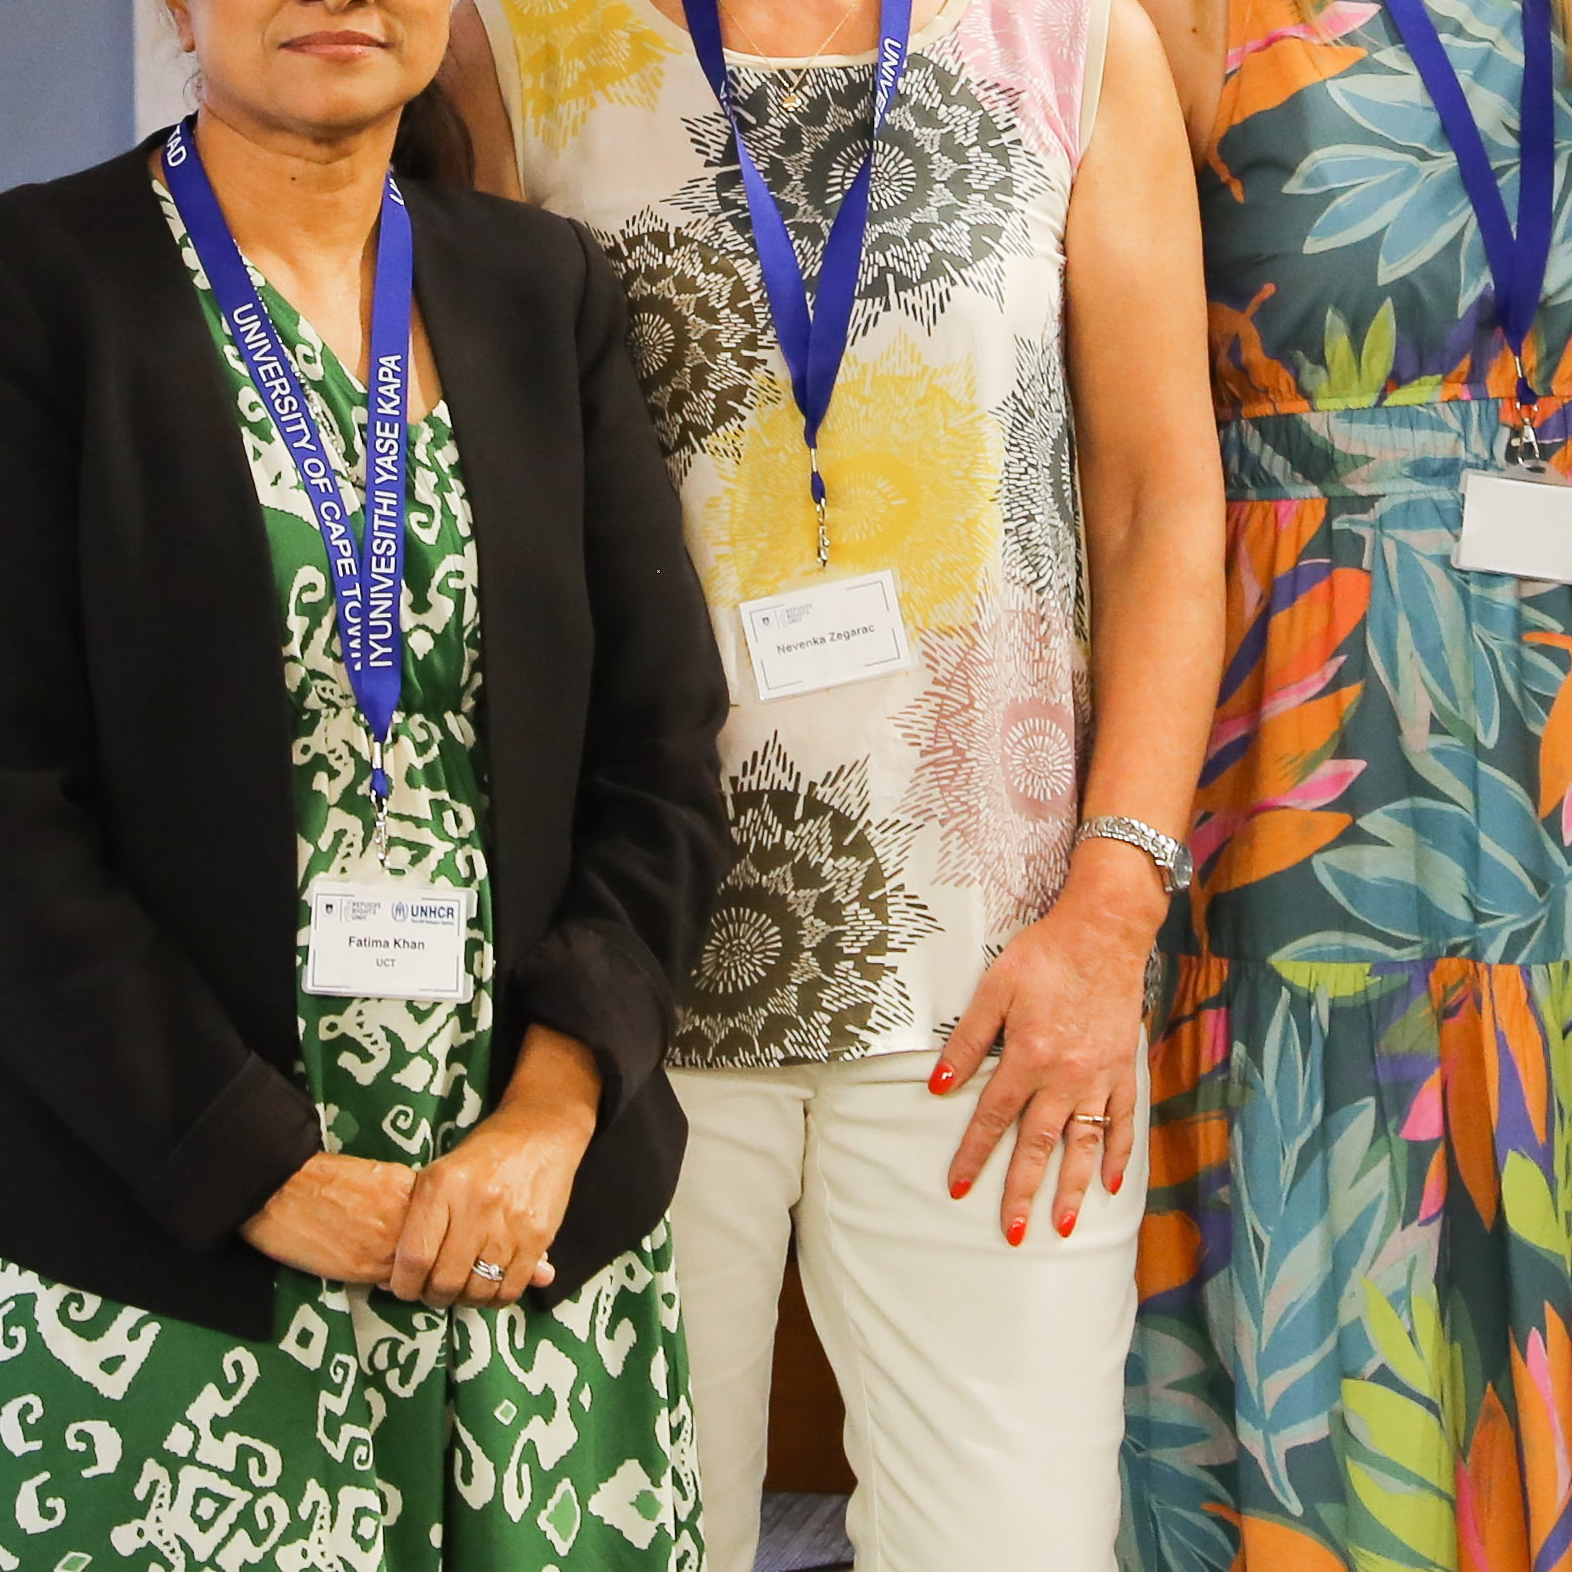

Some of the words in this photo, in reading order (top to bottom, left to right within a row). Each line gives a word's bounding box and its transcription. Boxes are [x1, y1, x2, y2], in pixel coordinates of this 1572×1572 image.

[376, 353, 404, 419] KAPA
[373, 419, 401, 491] YASE
[232, 302, 317, 452] UNIVERSITY
[302, 456, 334, 493] OF
[319, 497, 359, 578] CAPE
[339, 580, 363, 672] TOW
[368, 493, 399, 668] IYUNIVESITHI
[777, 636, 826, 654] Nevenka
[829, 624, 875, 642] Zegarac
[411, 905, 454, 919] UNHCR
[349, 937, 389, 949] Fatima
[393, 938, 425, 950] Khan
[376, 959, 396, 968] UCT
